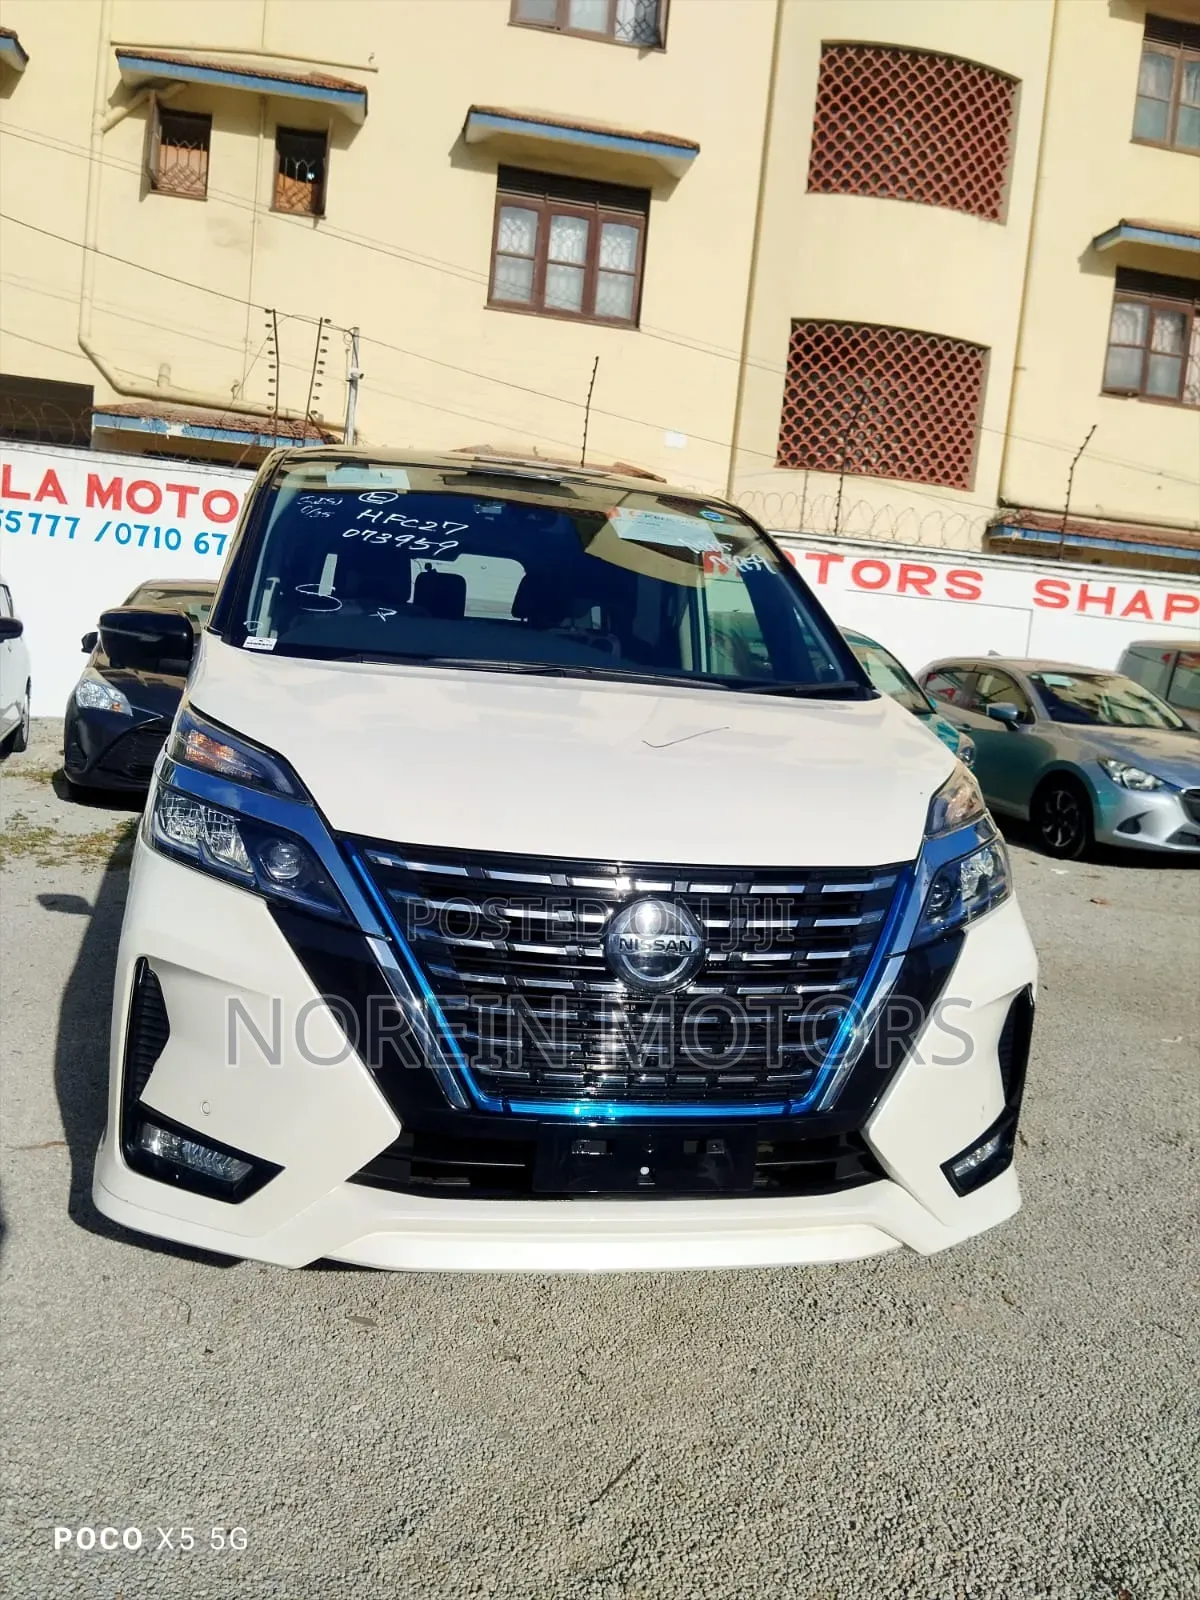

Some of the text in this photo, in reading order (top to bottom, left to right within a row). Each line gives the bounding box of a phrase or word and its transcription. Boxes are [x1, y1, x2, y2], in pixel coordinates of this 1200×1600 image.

[1, 463, 239, 524] LA MOTO
[0, 509, 80, 539] 5777
[193, 532, 229, 556] 67
[356, 509, 470, 535] HFC27
[342, 528, 460, 556] 073959
[1032, 579, 1200, 621] SHAP
[619, 938, 692, 952] NISSAN
